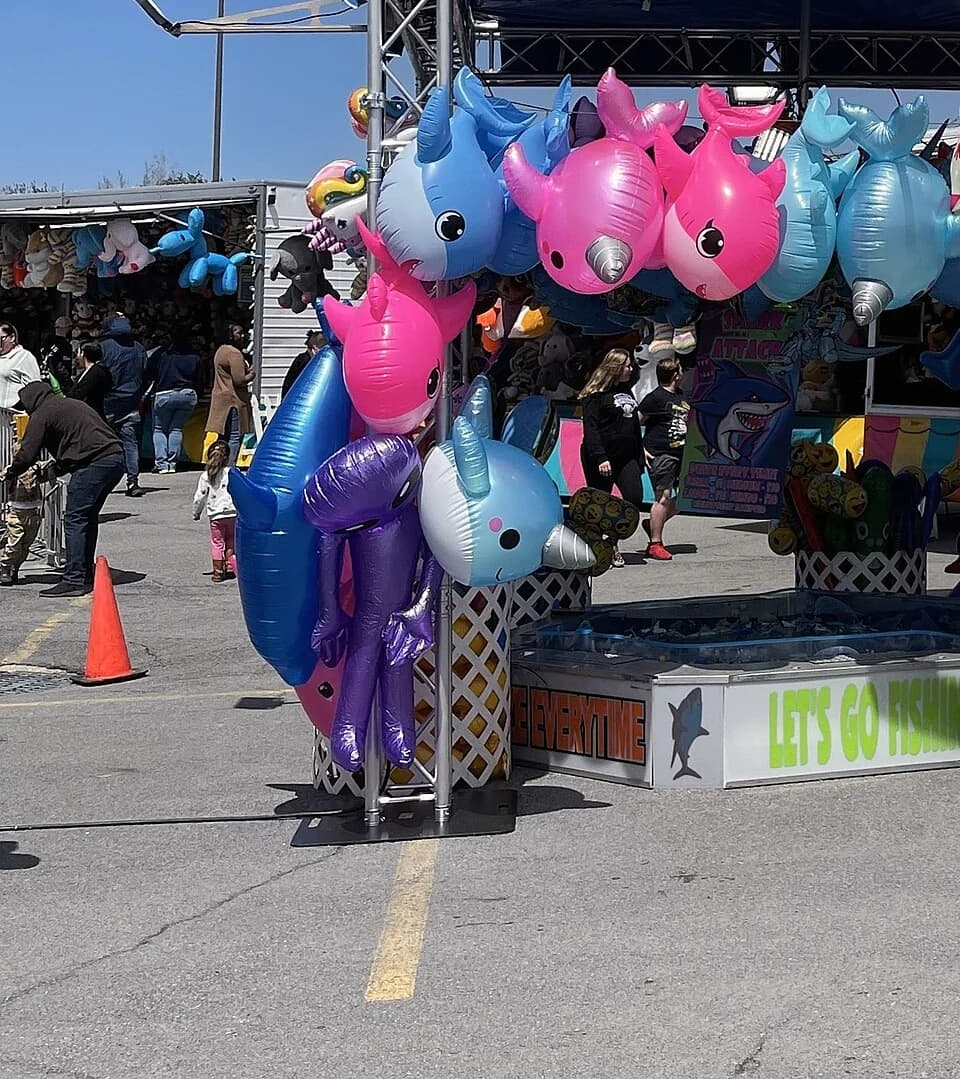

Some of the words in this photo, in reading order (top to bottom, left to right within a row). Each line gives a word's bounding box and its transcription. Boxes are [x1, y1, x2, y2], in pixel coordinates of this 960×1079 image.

[530, 686, 646, 766] EVERYTIME
[768, 685, 833, 769] LET'S
[840, 677, 879, 762] GO
